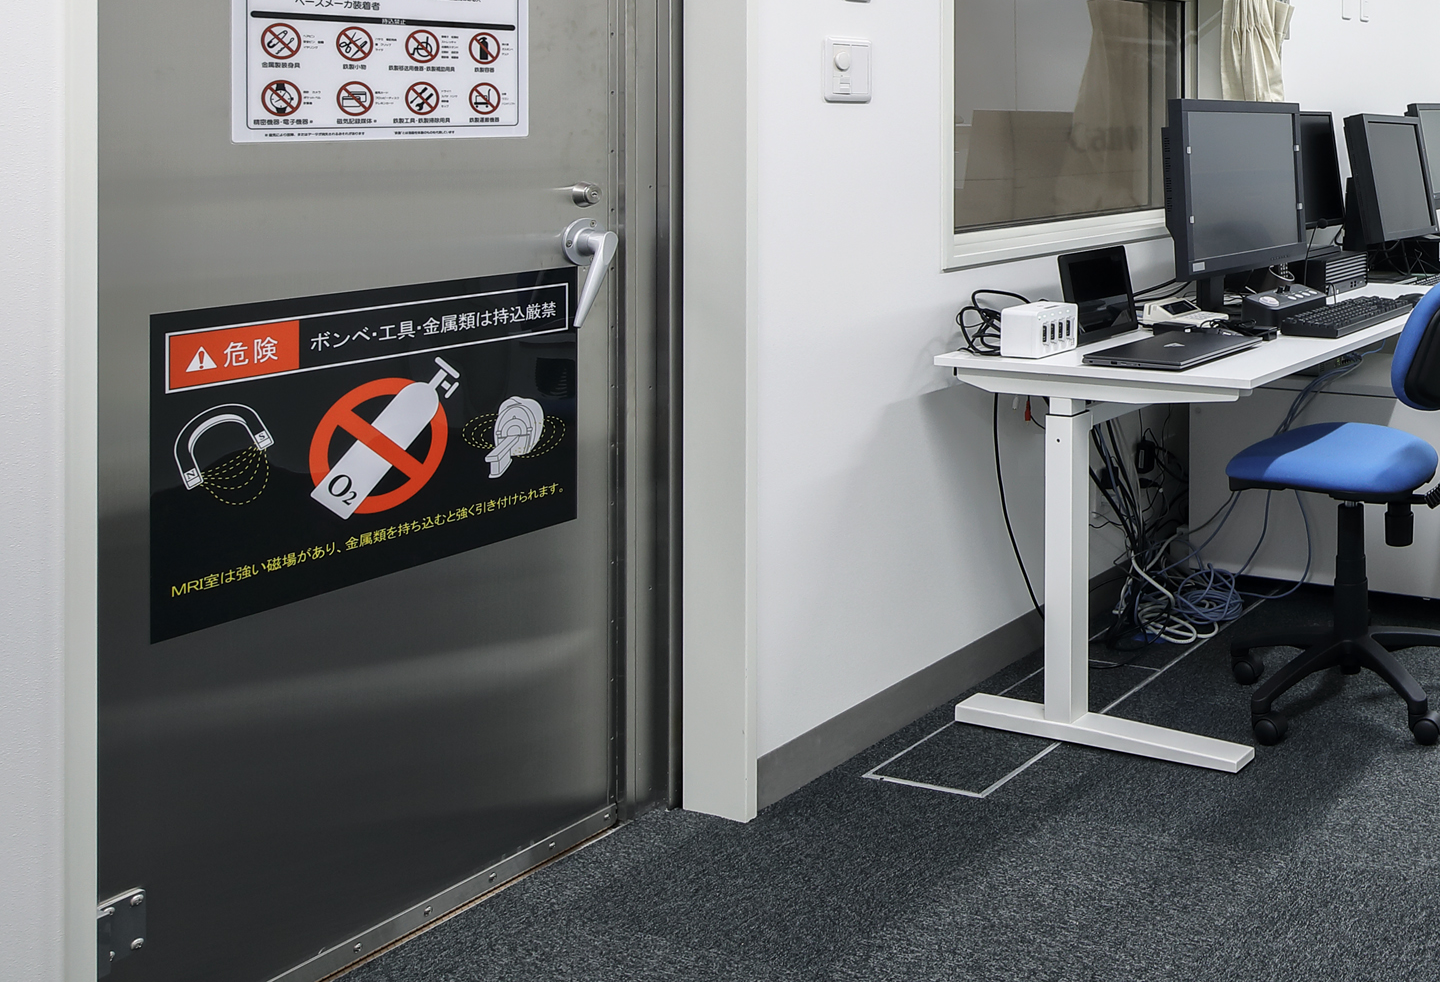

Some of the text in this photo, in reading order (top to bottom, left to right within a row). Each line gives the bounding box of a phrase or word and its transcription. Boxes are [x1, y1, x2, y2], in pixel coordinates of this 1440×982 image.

[222, 335, 279, 368] 危険
[309, 300, 558, 352] ボンベ・工具・金属類は持込厳禁
[171, 481, 565, 598] MRI室は強い磁場があり、金属類を持ち込むと強く引き付けられます。
